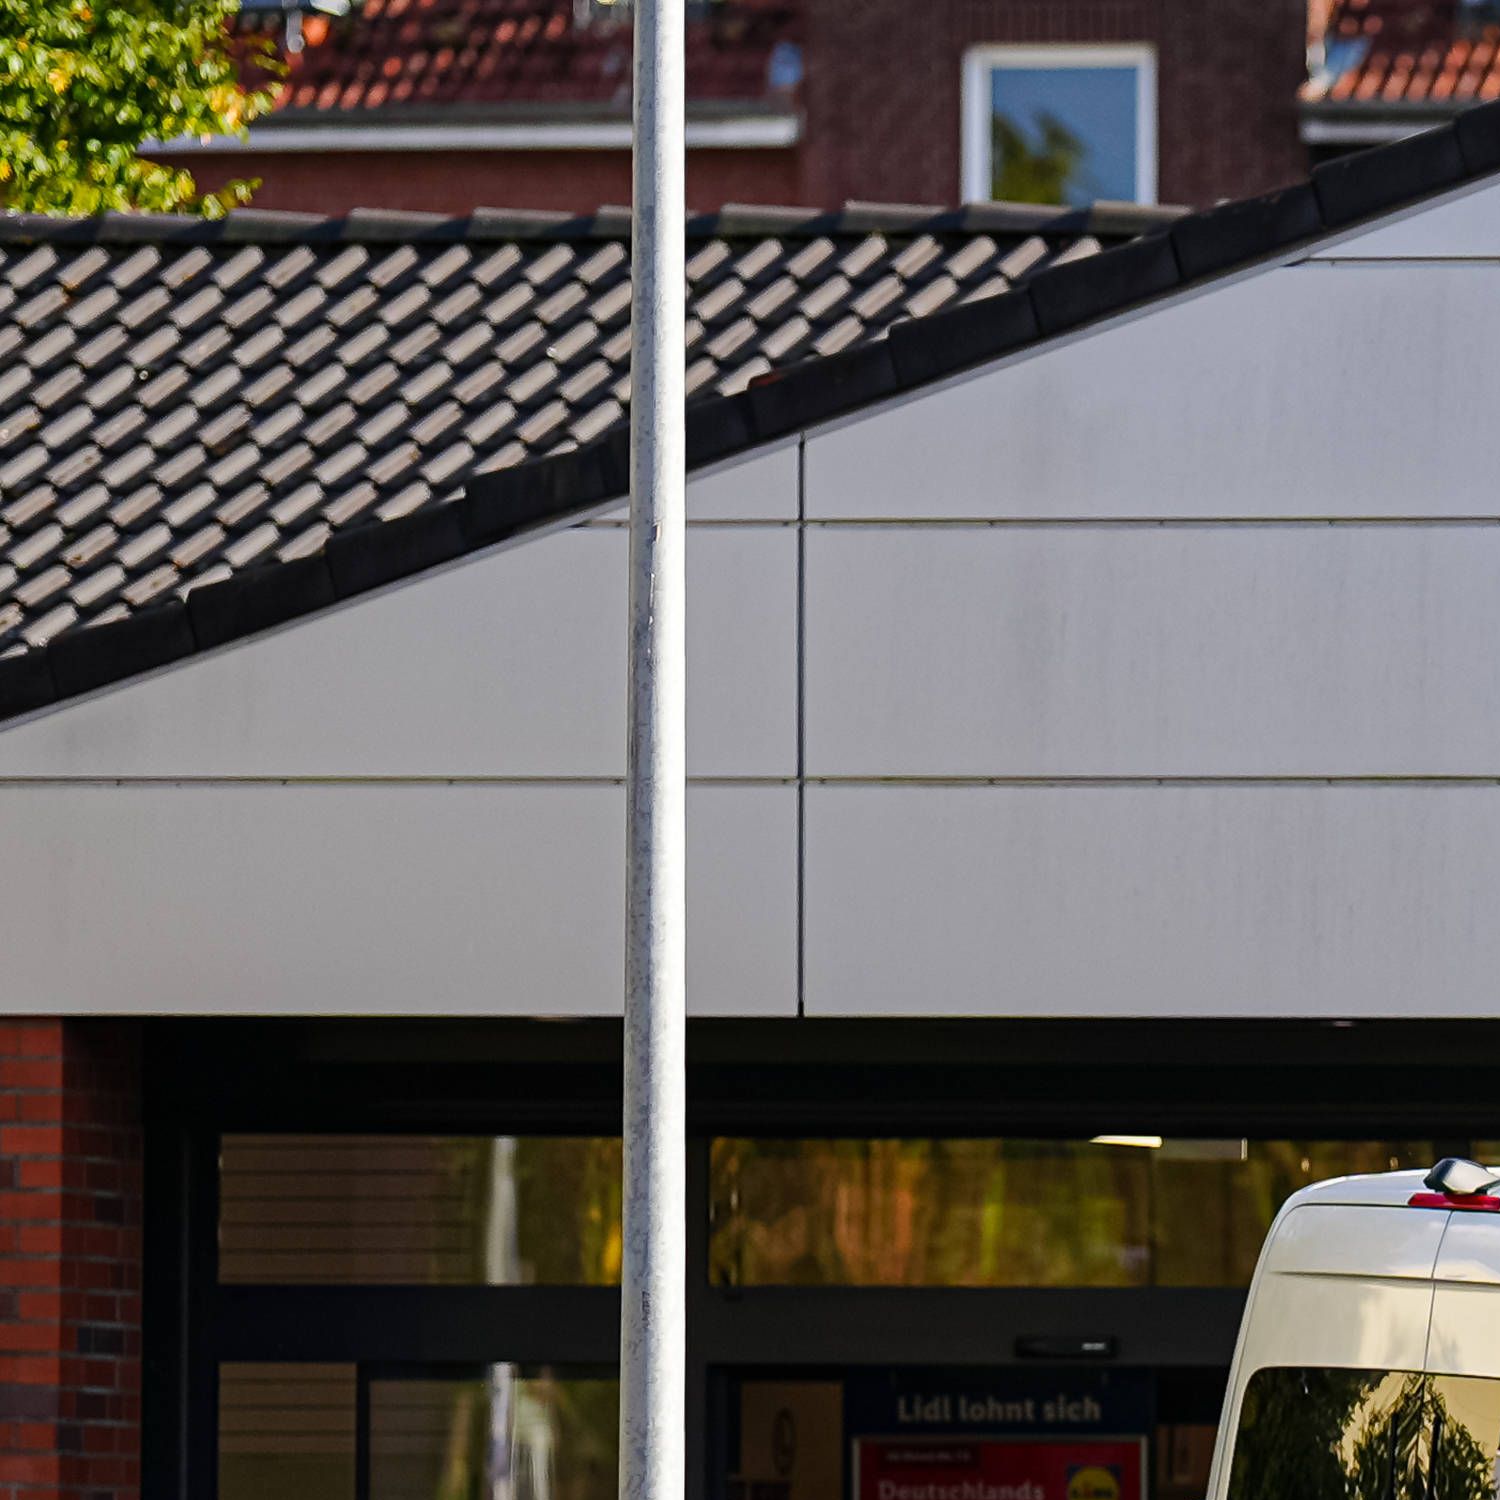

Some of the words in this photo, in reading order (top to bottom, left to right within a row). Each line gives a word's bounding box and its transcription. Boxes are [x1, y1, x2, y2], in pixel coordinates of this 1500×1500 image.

[897, 1394, 951, 1421] Lidl
[958, 1394, 1036, 1422] lohnt
[1042, 1394, 1101, 1422] sich
